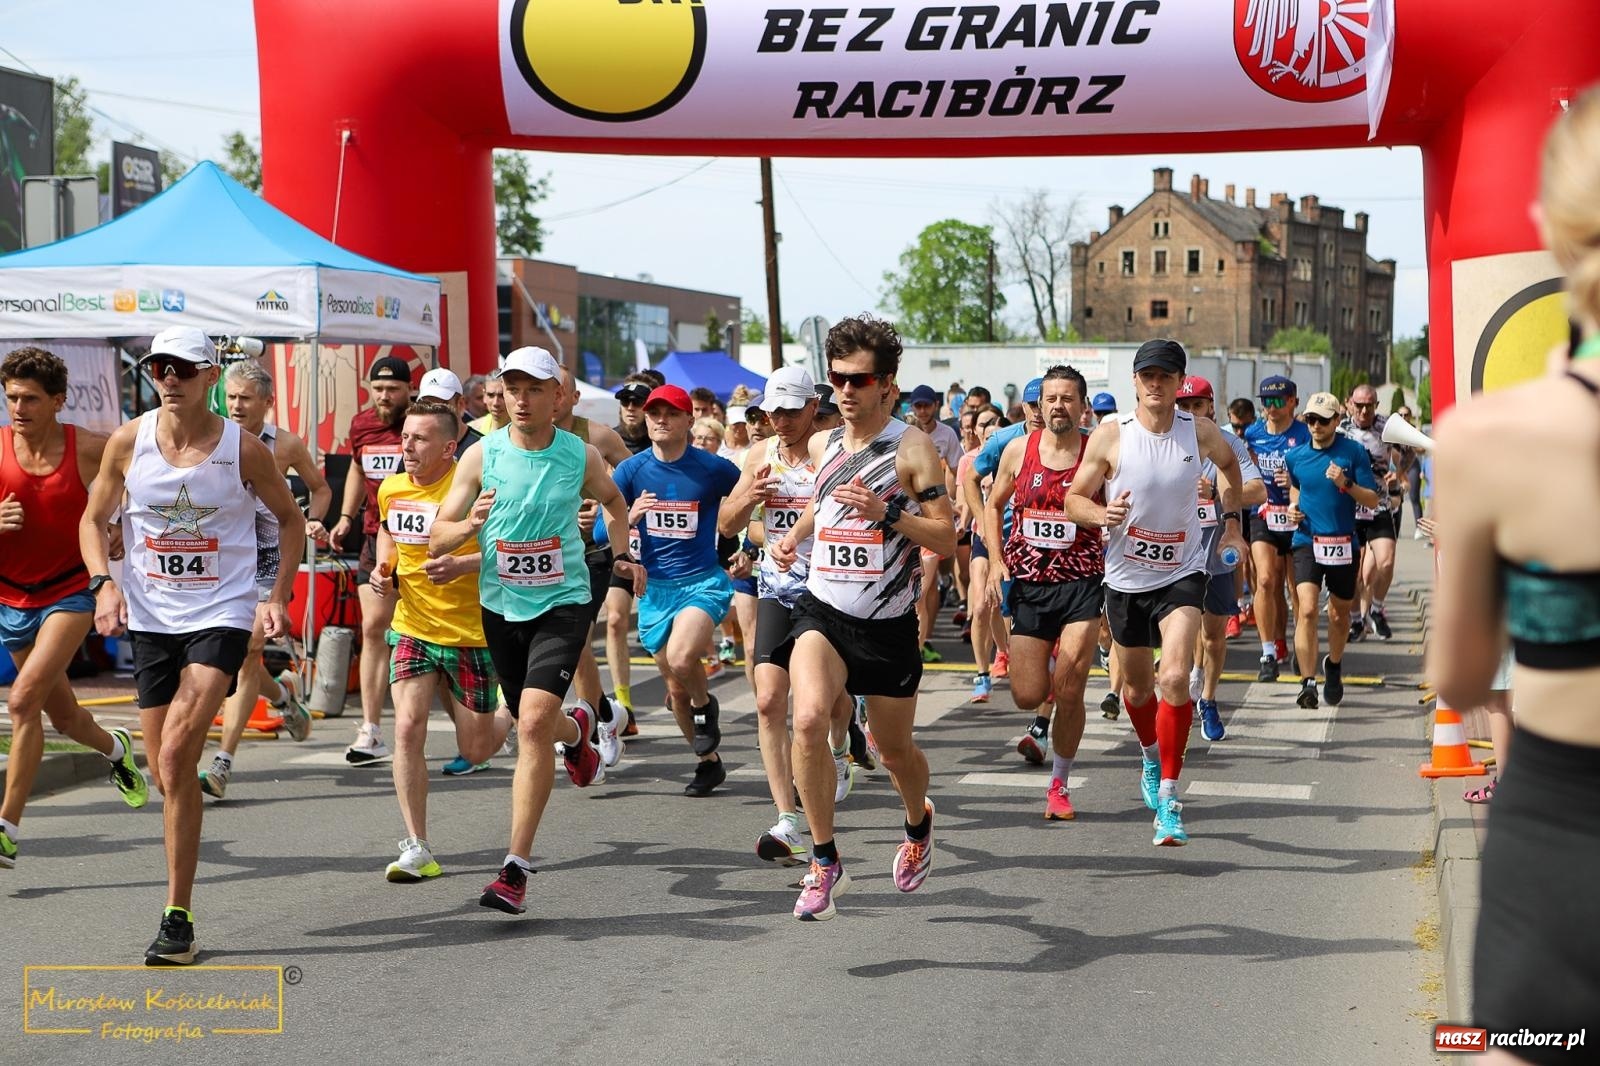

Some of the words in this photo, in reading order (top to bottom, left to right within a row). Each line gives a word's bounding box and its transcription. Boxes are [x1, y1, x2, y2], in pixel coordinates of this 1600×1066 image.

[757, 8, 895, 52] BEZ
[905, 0, 1160, 51] GRANIC
[793, 66, 1126, 119] RACIBÓRZ
[256, 301, 289, 311] MITKO
[327, 293, 375, 316] PersonalBest
[372, 456, 395, 470] 217
[396, 513, 425, 533] 143
[655, 513, 688, 529] 155
[774, 511, 803, 528] 20
[1273, 514, 1287, 524] 19
[1033, 521, 1065, 539] 138
[828, 545, 869, 568] 136
[1134, 541, 1175, 561] 236
[1322, 546, 1344, 557] 173
[157, 554, 205, 576] 184
[507, 554, 553, 575] 238
